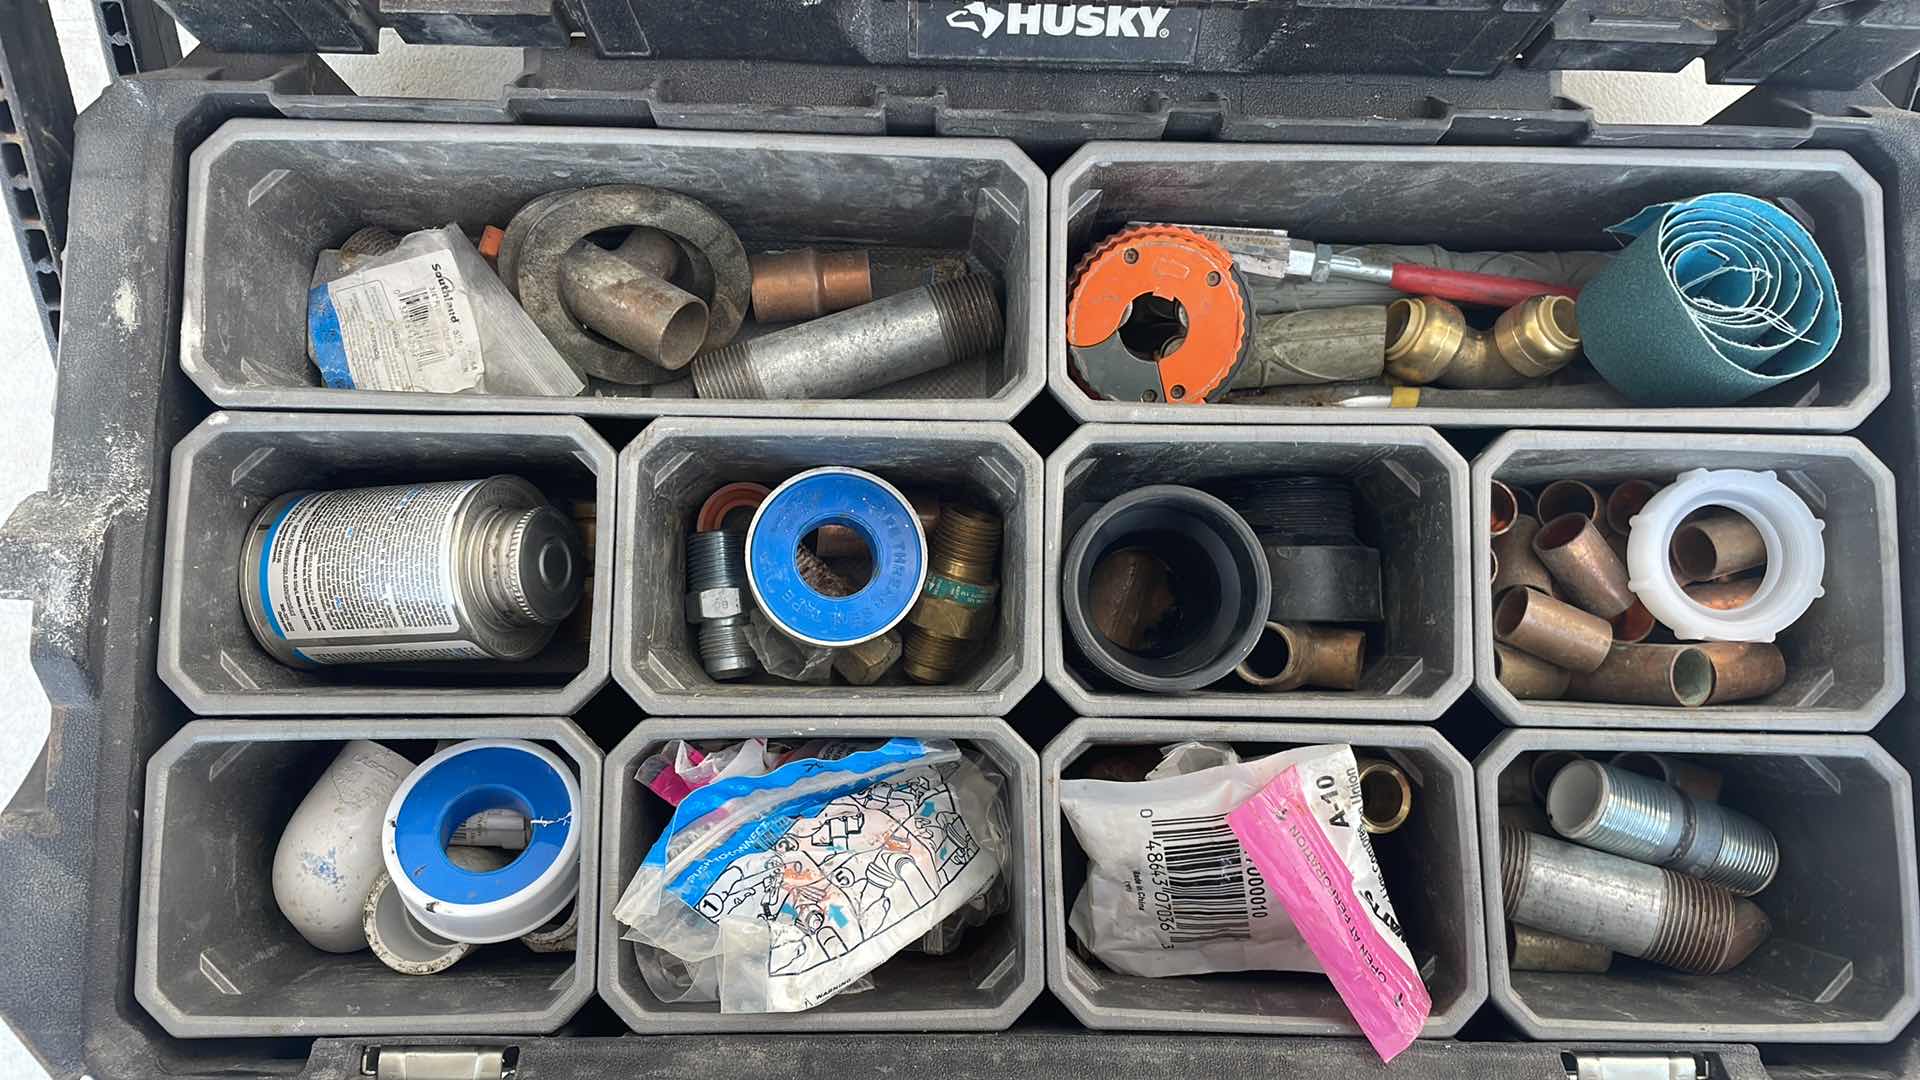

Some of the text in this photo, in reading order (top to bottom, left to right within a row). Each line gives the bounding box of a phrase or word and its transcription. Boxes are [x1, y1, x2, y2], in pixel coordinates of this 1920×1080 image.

[1006, 2, 1171, 38] HUSKY
[431, 263, 460, 324] Southland
[1316, 775, 1350, 828] A-10
[1346, 767, 1363, 805] Union
[1139, 808, 1153, 818] 0
[1146, 840, 1169, 887] 48643
[1138, 892, 1146, 910] China
[1154, 891, 1175, 931] 07036
[1288, 823, 1388, 984] OPEN AT PERFORATION
